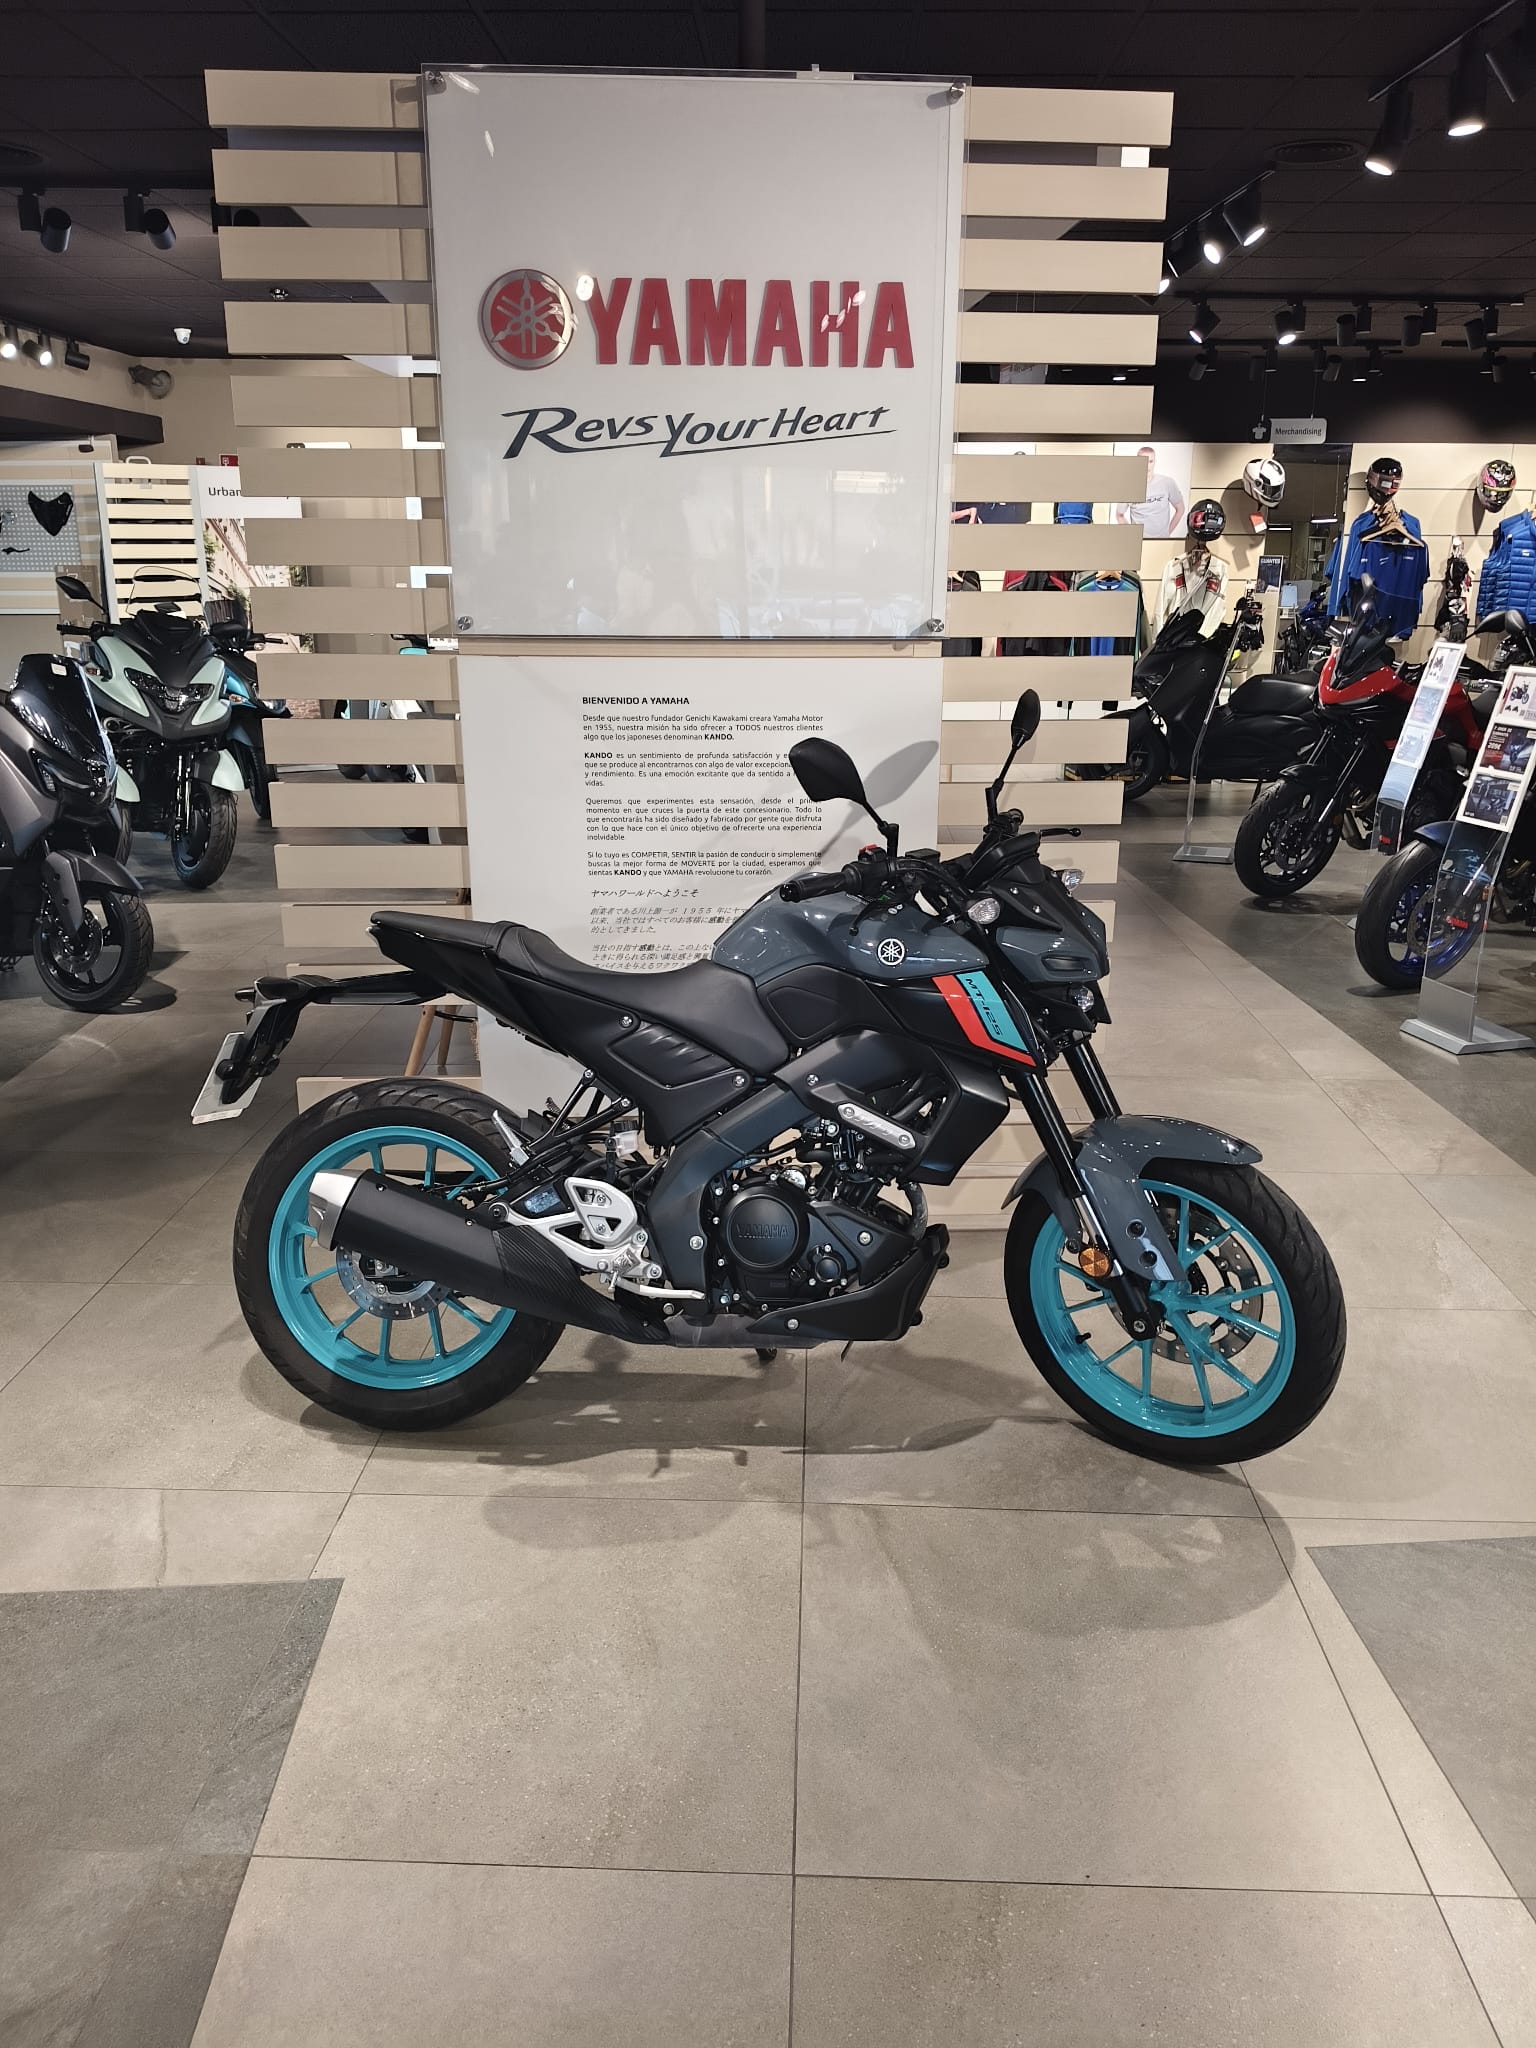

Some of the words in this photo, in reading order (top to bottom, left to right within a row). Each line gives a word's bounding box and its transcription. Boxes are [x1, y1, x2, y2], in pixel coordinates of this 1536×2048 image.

[586, 277, 915, 369] YAMAHA
[501, 407, 659, 459] Revs
[659, 411, 770, 457] Your
[768, 406, 891, 438] Heart
[1275, 427, 1322, 436] Merchandising
[581, 696, 640, 705] BIENVENIDO
[641, 696, 649, 705] A
[649, 696, 691, 705] YAMAHA
[582, 713, 606, 722] Desde
[606, 715, 621, 724] que
[621, 713, 650, 722] nuestro
[650, 713, 684, 722] fundador
[685, 713, 711, 722] Genichi
[712, 713, 748, 721] Kawakami
[772, 713, 800, 721] Yamaha
[801, 713, 824, 721] Motor
[595, 723, 615, 732] 1955,
[616, 723, 644, 731] nuestra
[646, 723, 670, 731] misión
[671, 723, 681, 731] ha
[683, 723, 698, 731] sido
[700, 722, 727, 730] ofrecer
[735, 722, 761, 730] TODOS
[763, 722, 794, 730] nuestros
[796, 722, 824, 730] clientes
[583, 732, 599, 743] algo
[600, 734, 614, 743] que
[615, 732, 626, 741] los
[626, 732, 663, 743] japoneses
[663, 732, 703, 741] denominan
[704, 732, 735, 740] KANDO.
[584, 750, 613, 759] KANDO
[639, 750, 682, 759] sentimiento
[684, 750, 694, 759] de
[697, 750, 729, 760] profunda
[732, 750, 773, 758] satisfacción
[775, 752, 780, 760] y
[584, 762, 598, 770] que
[608, 760, 638, 770] produce
[639, 760, 646, 768] al
[647, 760, 694, 768] encontrarnos
[708, 759, 724, 770] algo
[725, 759, 735, 768] de
[735, 759, 754, 768] valor
[754, 759, 793, 770] excepciona
[583, 771, 590, 780] y
[638, 769, 648, 777] Es
[664, 769, 695, 777] emoción
[696, 768, 729, 777] excitante
[730, 770, 745, 779] que
[746, 768, 756, 777] da
[757, 768, 785, 777] sentido
[585, 796, 623, 807] Queremos
[627, 798, 642, 807] que
[646, 796, 695, 807] experimentes
[699, 796, 715, 804] esta
[760, 796, 782, 804] desde
[787, 796, 794, 804] el
[799, 796, 823, 806] pri
[586, 805, 620, 814] momento
[635, 807, 649, 816] que
[676, 805, 684, 814] la
[686, 805, 710, 816] puerta
[712, 805, 722, 813] de
[724, 805, 740, 813] este
[742, 805, 792, 813] concesionario.
[794, 805, 813, 813] Todo
[815, 805, 823, 813] lo
[586, 816, 600, 825] que
[601, 814, 643, 823] encontrarás
[644, 814, 654, 823] ha
[655, 814, 670, 823] sido
[671, 814, 703, 823] diseñado
[704, 816, 709, 824] y
[710, 814, 743, 822] fabricado
[744, 816, 757, 824] por
[758, 814, 779, 824] gente
[780, 816, 794, 824] que
[795, 814, 822, 822] disfruta
[601, 823, 609, 832] lo
[611, 825, 625, 834] que
[626, 823, 644, 832] hace
[660, 823, 668, 832] el
[669, 823, 689, 832] único
[690, 823, 719, 833] objetivo
[721, 823, 731, 831] de
[732, 823, 765, 831] ofrecerte
[782, 823, 822, 833] experiencia
[586, 850, 594, 858] Si
[595, 850, 603, 858] lo
[603, 850, 620, 860] tuyo
[630, 850, 670, 859] COMPETIR,
[671, 850, 697, 858] SENTIR
[697, 849, 705, 858] la
[705, 849, 729, 860] pasión
[729, 849, 739, 858] de
[740, 849, 770, 858] conducir
[777, 849, 823, 860] simplemente
[587, 859, 611, 867] buscas
[613, 859, 620, 867] la
[622, 859, 643, 869] mejor
[645, 859, 667, 867] forma
[669, 859, 679, 867] de
[680, 859, 716, 867] MOVERTE
[718, 860, 731, 869] por
[732, 858, 739, 866] la
[741, 858, 766, 868] ciudad,
[768, 860, 806, 869] esperamos
[808, 860, 821, 869] que
[587, 868, 613, 876] sientas
[613, 868, 642, 876] KANDO
[642, 870, 648, 878] y
[648, 870, 662, 878] que
[662, 868, 694, 876] YAMAHA
[694, 867, 735, 875] revolucione
[735, 867, 744, 875] tu
[591, 888, 699, 898] ヤマハワールドへようこそ
[965, 978, 1003, 1036] MT-125
